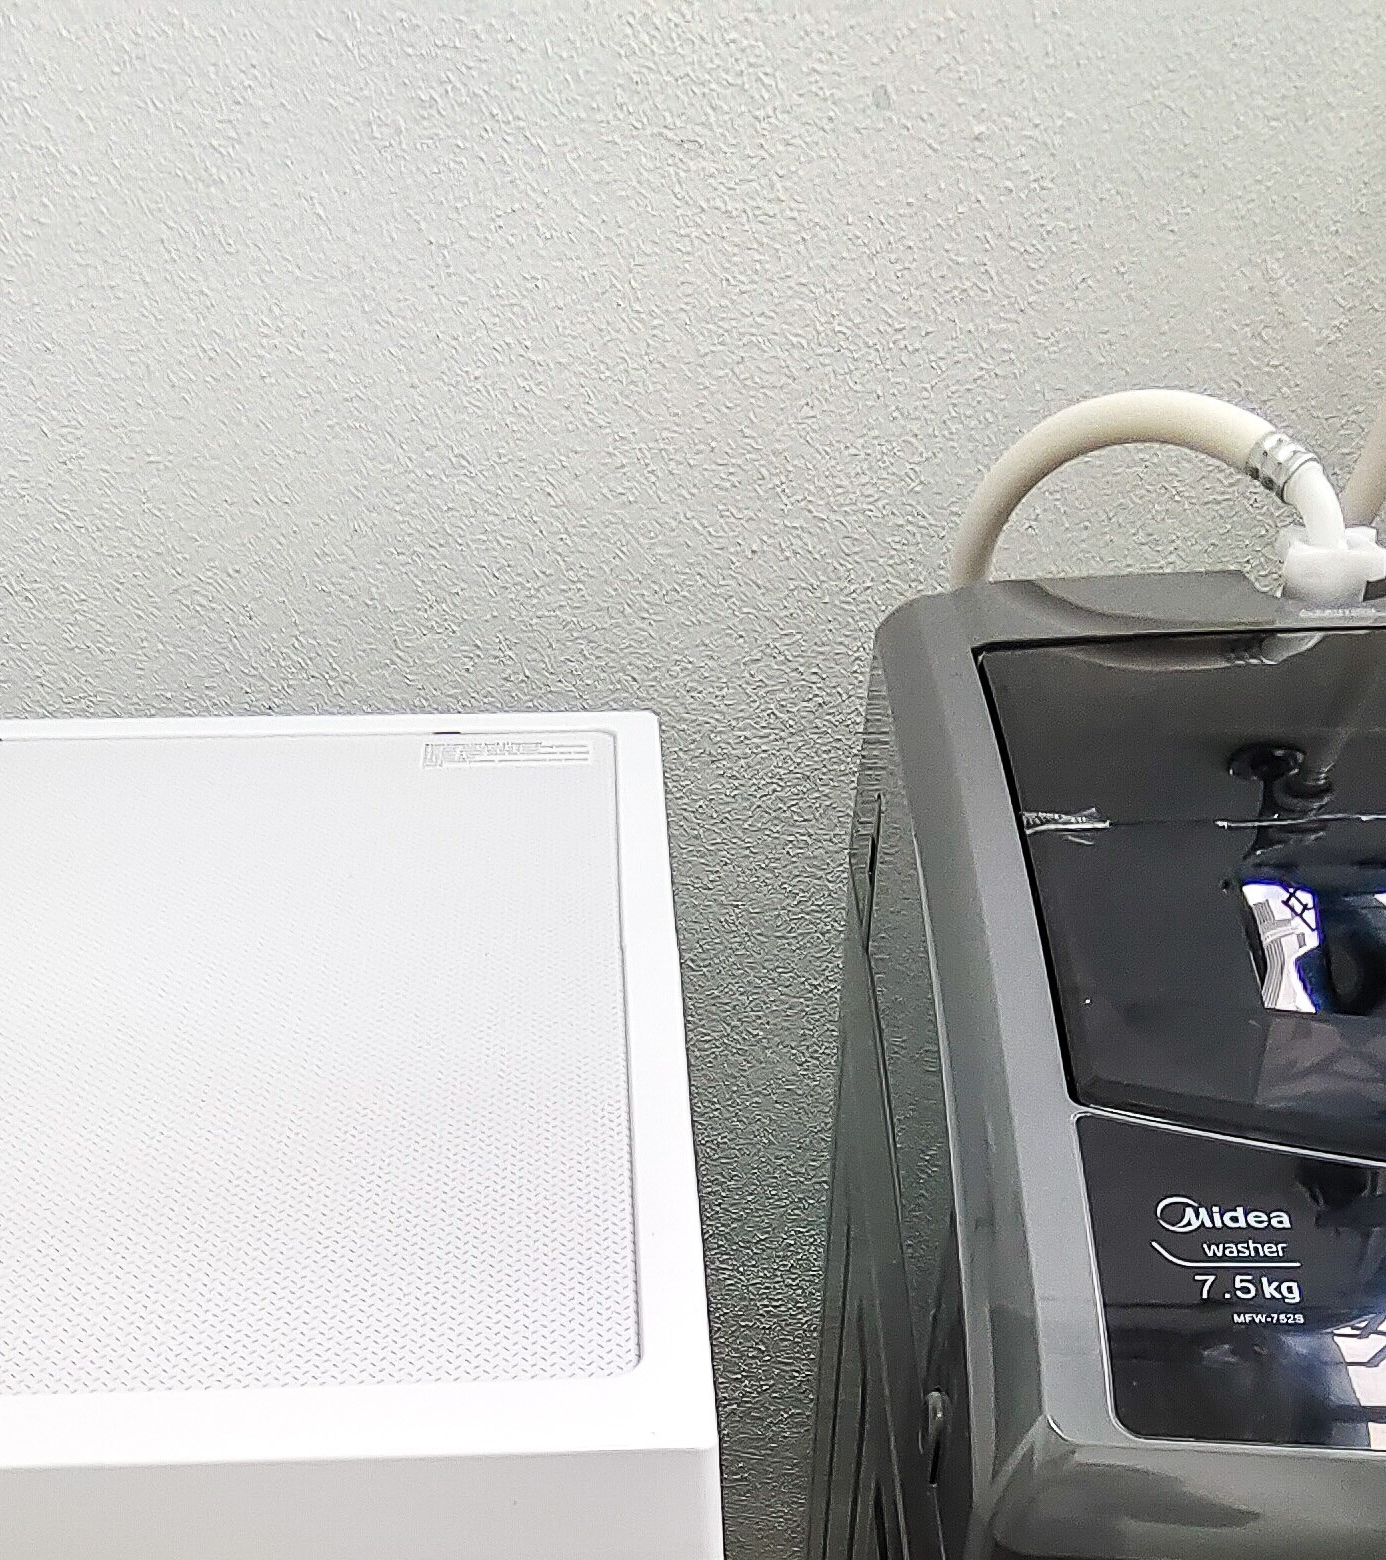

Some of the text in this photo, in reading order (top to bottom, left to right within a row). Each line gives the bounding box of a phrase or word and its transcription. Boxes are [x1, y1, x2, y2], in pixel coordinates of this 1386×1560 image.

[1158, 1198, 1291, 1231] Midea
[1202, 1240, 1287, 1259] washer
[1195, 1275, 1301, 1303] 7.5 kg
